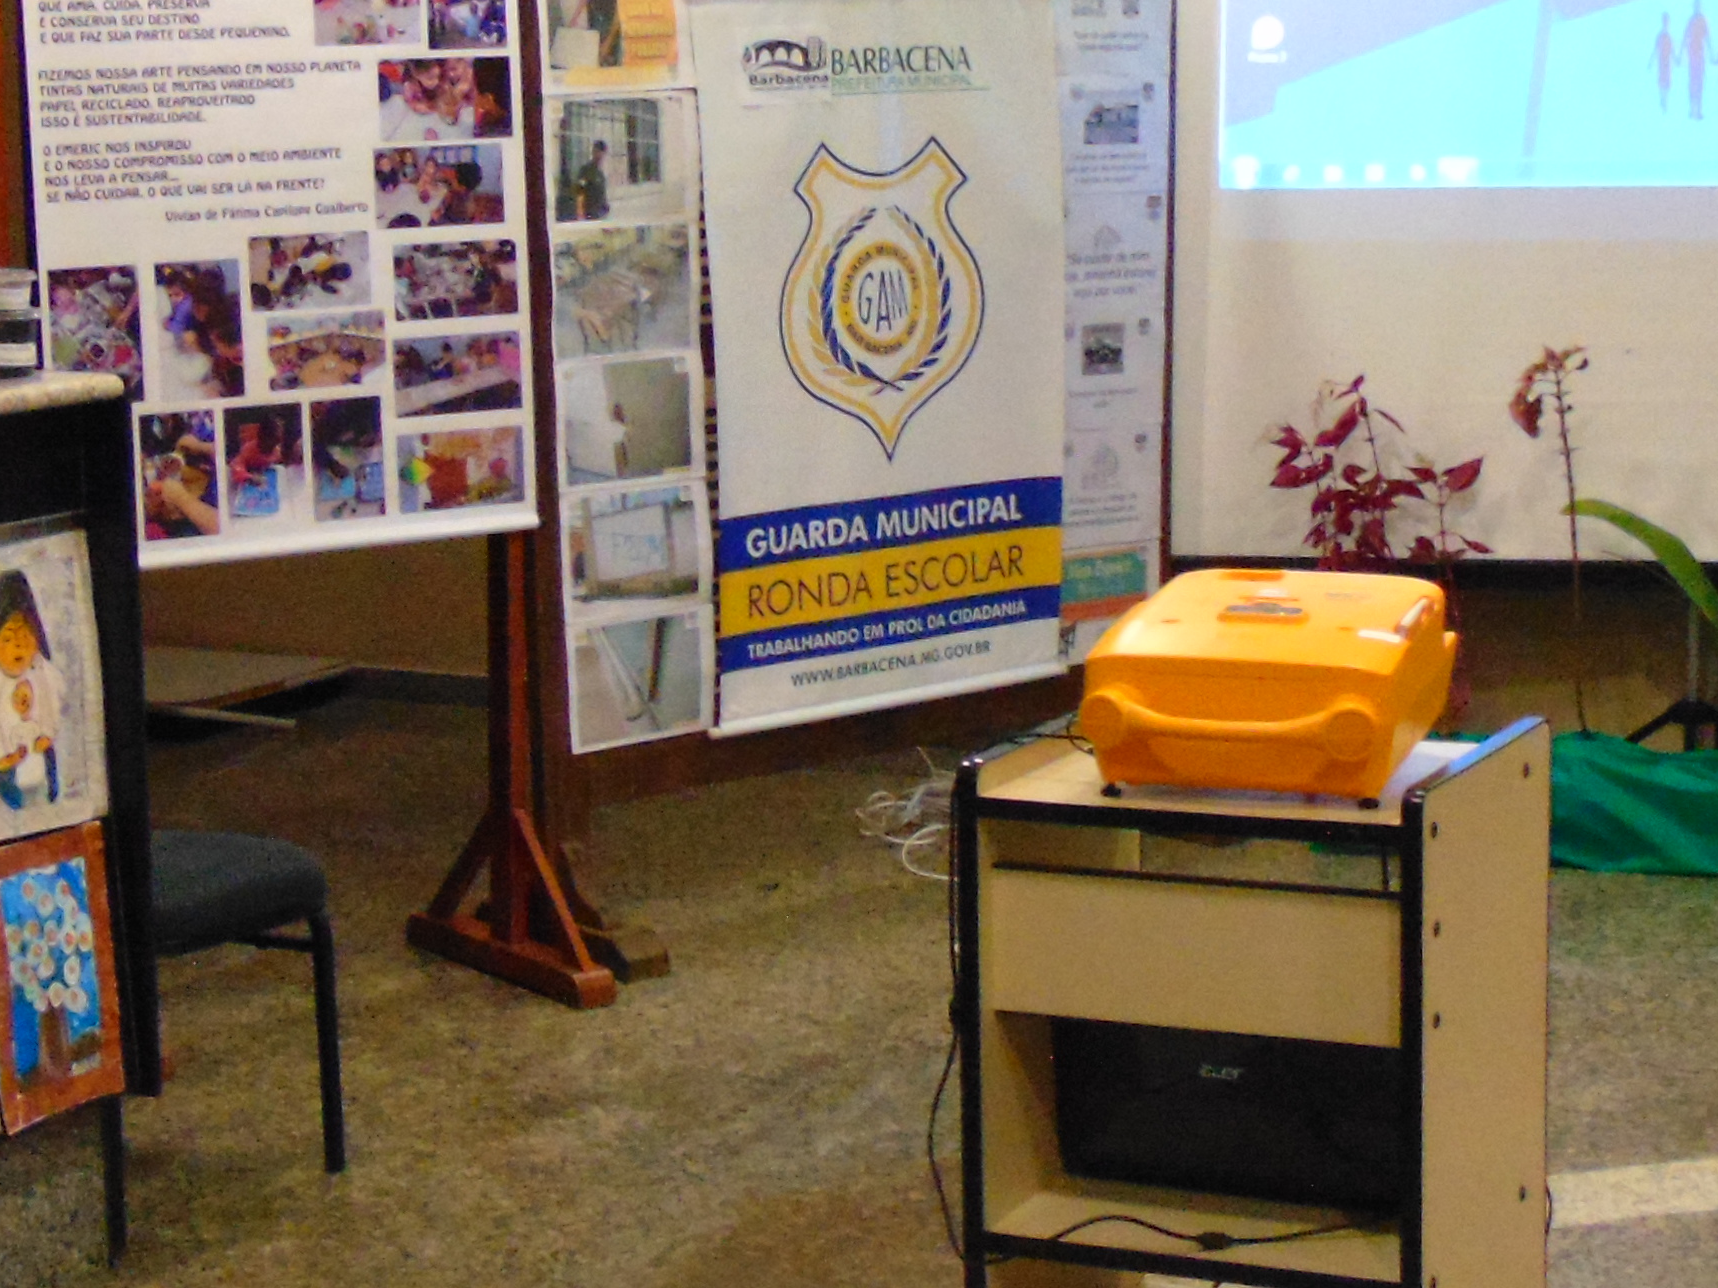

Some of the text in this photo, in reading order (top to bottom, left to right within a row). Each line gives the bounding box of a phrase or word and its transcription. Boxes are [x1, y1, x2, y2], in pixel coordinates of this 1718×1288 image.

[38, 0, 62, 12] QUE
[50, 15, 117, 27] CONSERVA
[121, 14, 145, 26] SEU
[148, 13, 201, 25] DESTINO
[51, 31, 76, 43] QUE
[80, 30, 102, 43] FAZ
[107, 29, 132, 42] SUA
[135, 28, 174, 41] PARTE
[178, 27, 216, 40] DESDE
[831, 45, 973, 76] BARBACENA
[38, 60, 361, 81] FIZEMOS NOSSA ARTE PENSANDO EM NOSSO PLANETA
[749, 73, 829, 86] Barbacena
[40, 78, 295, 97] TINTAS NATURAIS DE MUITAS VARIEDADES
[40, 100, 77, 112] PAPEL
[157, 94, 256, 108] REAPROVEITADO
[40, 116, 70, 128] ISSO
[43, 145, 51, 157] O
[105, 142, 131, 154] NOS
[135, 140, 192, 153] INSPIROU
[55, 160, 64, 171] O
[67, 158, 111, 170] NOSSO
[114, 154, 203, 169] COMPROMISSO
[207, 152, 234, 164] COM
[237, 151, 246, 162] O
[249, 150, 279, 162] MEIO
[283, 147, 342, 161] AMBIENTE
[45, 175, 69, 187] NOS
[74, 173, 105, 185] LEVA
[108, 172, 118, 184] A
[46, 191, 60, 203] SE
[64, 187, 91, 202] NÃO
[147, 186, 156, 197] O
[160, 185, 183, 197] QUE
[211, 183, 234, 195] SER
[256, 180, 274, 192] NA
[205, 209, 218, 220] de
[858, 269, 909, 333] GAM
[745, 514, 870, 559] GUARDA
[875, 492, 1024, 542] MUNICIPAL
[747, 544, 1025, 620] RONDA ESCOLAR
[747, 599, 1028, 661] TRABALHANDO EM PROL DA CIDADANIA
